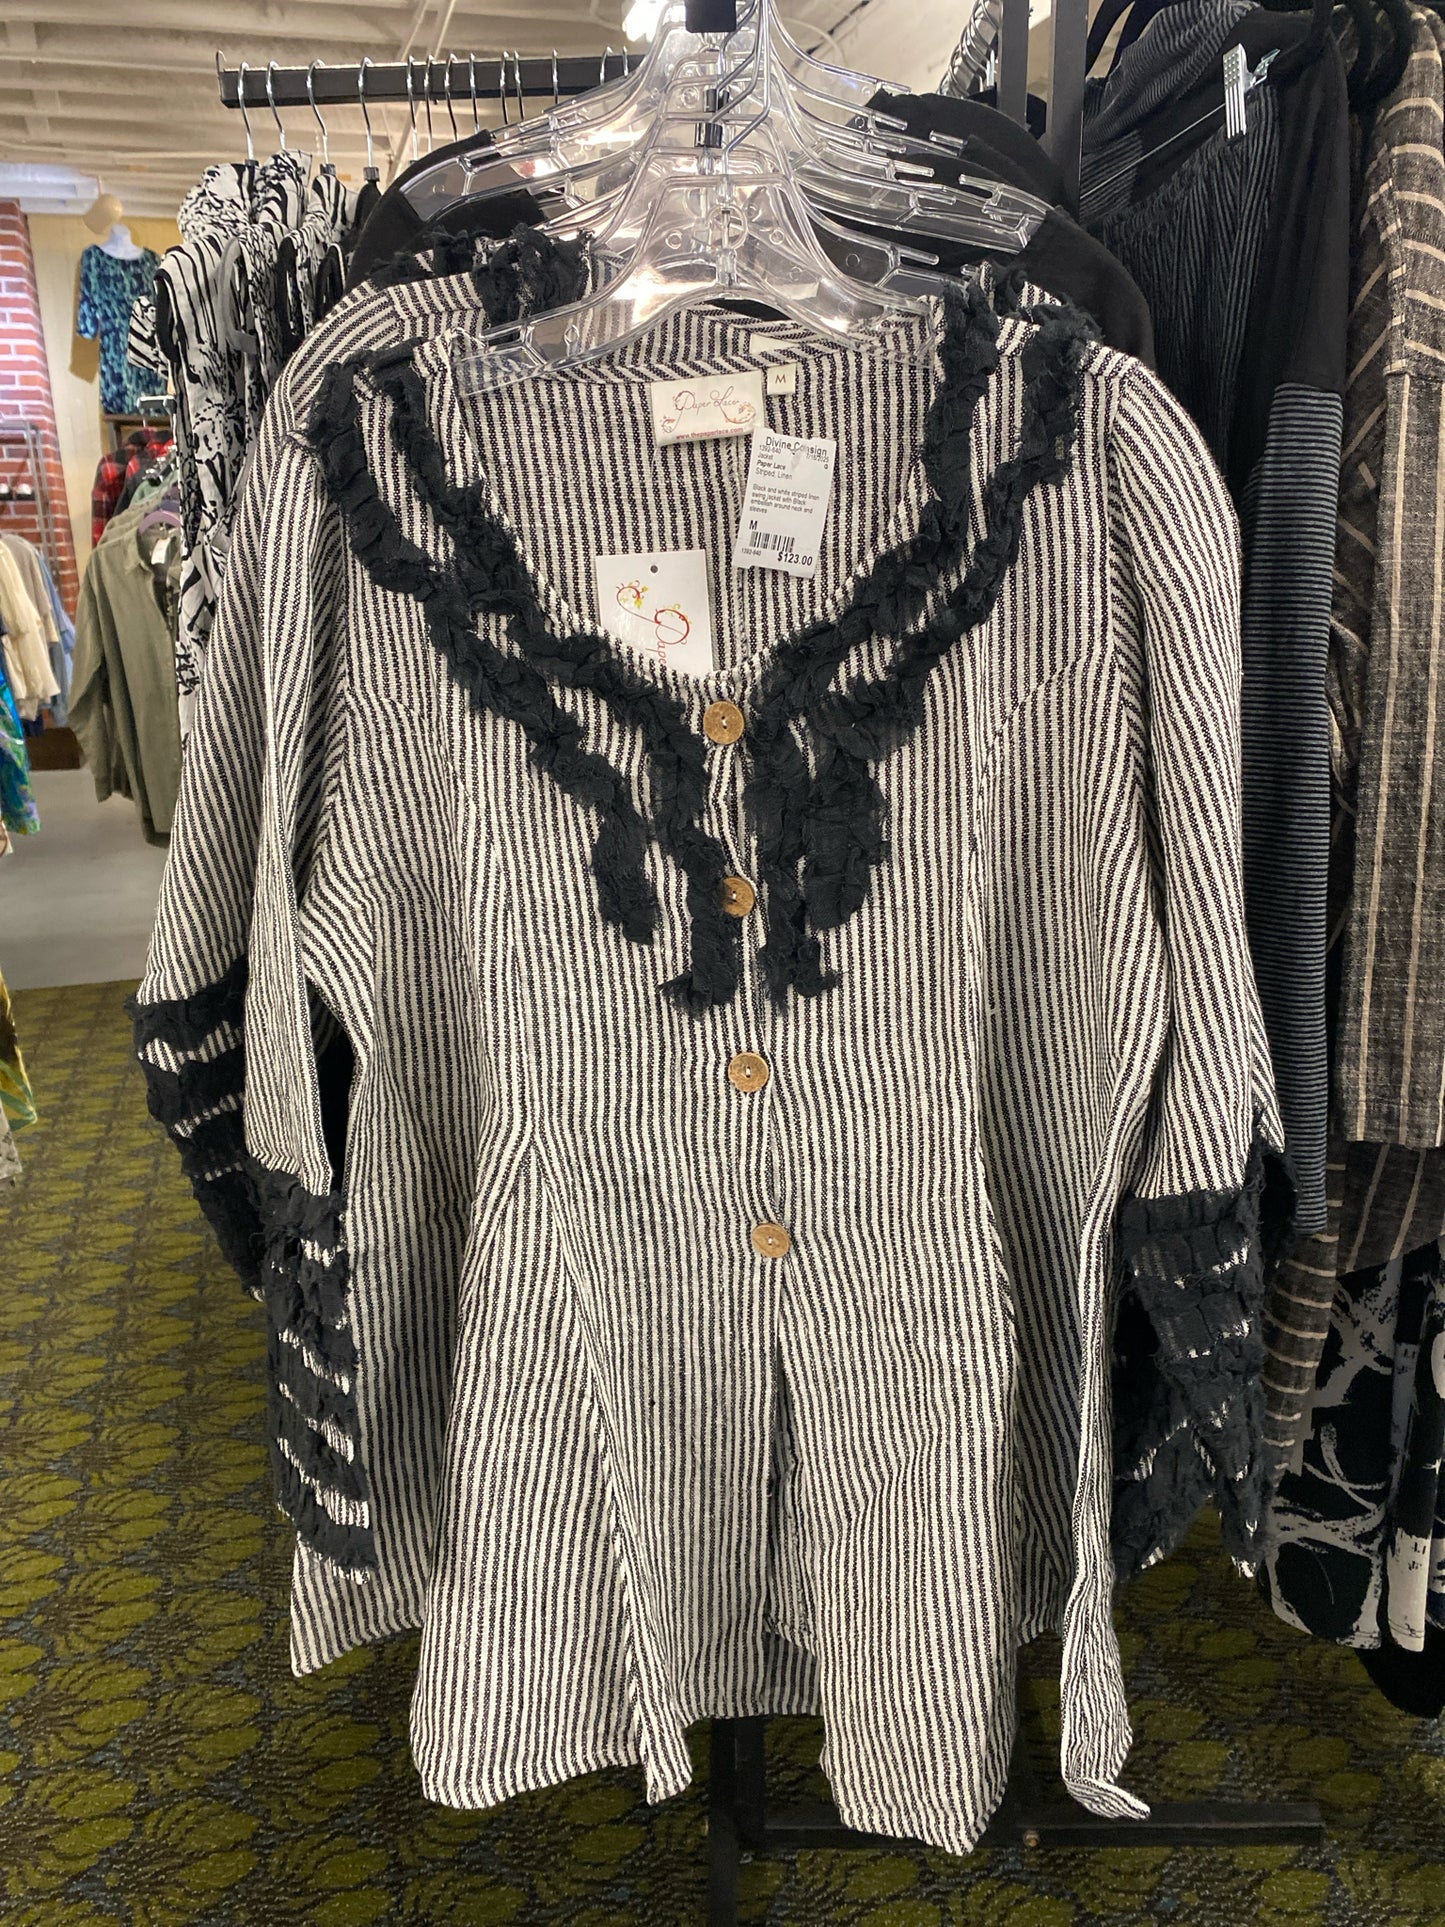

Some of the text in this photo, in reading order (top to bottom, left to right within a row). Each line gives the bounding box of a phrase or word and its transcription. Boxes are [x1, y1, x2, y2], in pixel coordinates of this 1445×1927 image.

[775, 374, 786, 384] M
[675, 427, 744, 440] www.thepaperlace.com
[766, 436, 792, 450] Divine
[756, 459, 786, 470] Paper Lace
[777, 471, 793, 480] Linen
[753, 483, 767, 492] Black
[791, 490, 808, 499] striped
[765, 494, 781, 502] jacket
[792, 497, 806, 505] Black
[750, 506, 768, 514] sleeves
[749, 520, 758, 530] M
[777, 552, 813, 566] $123.00
